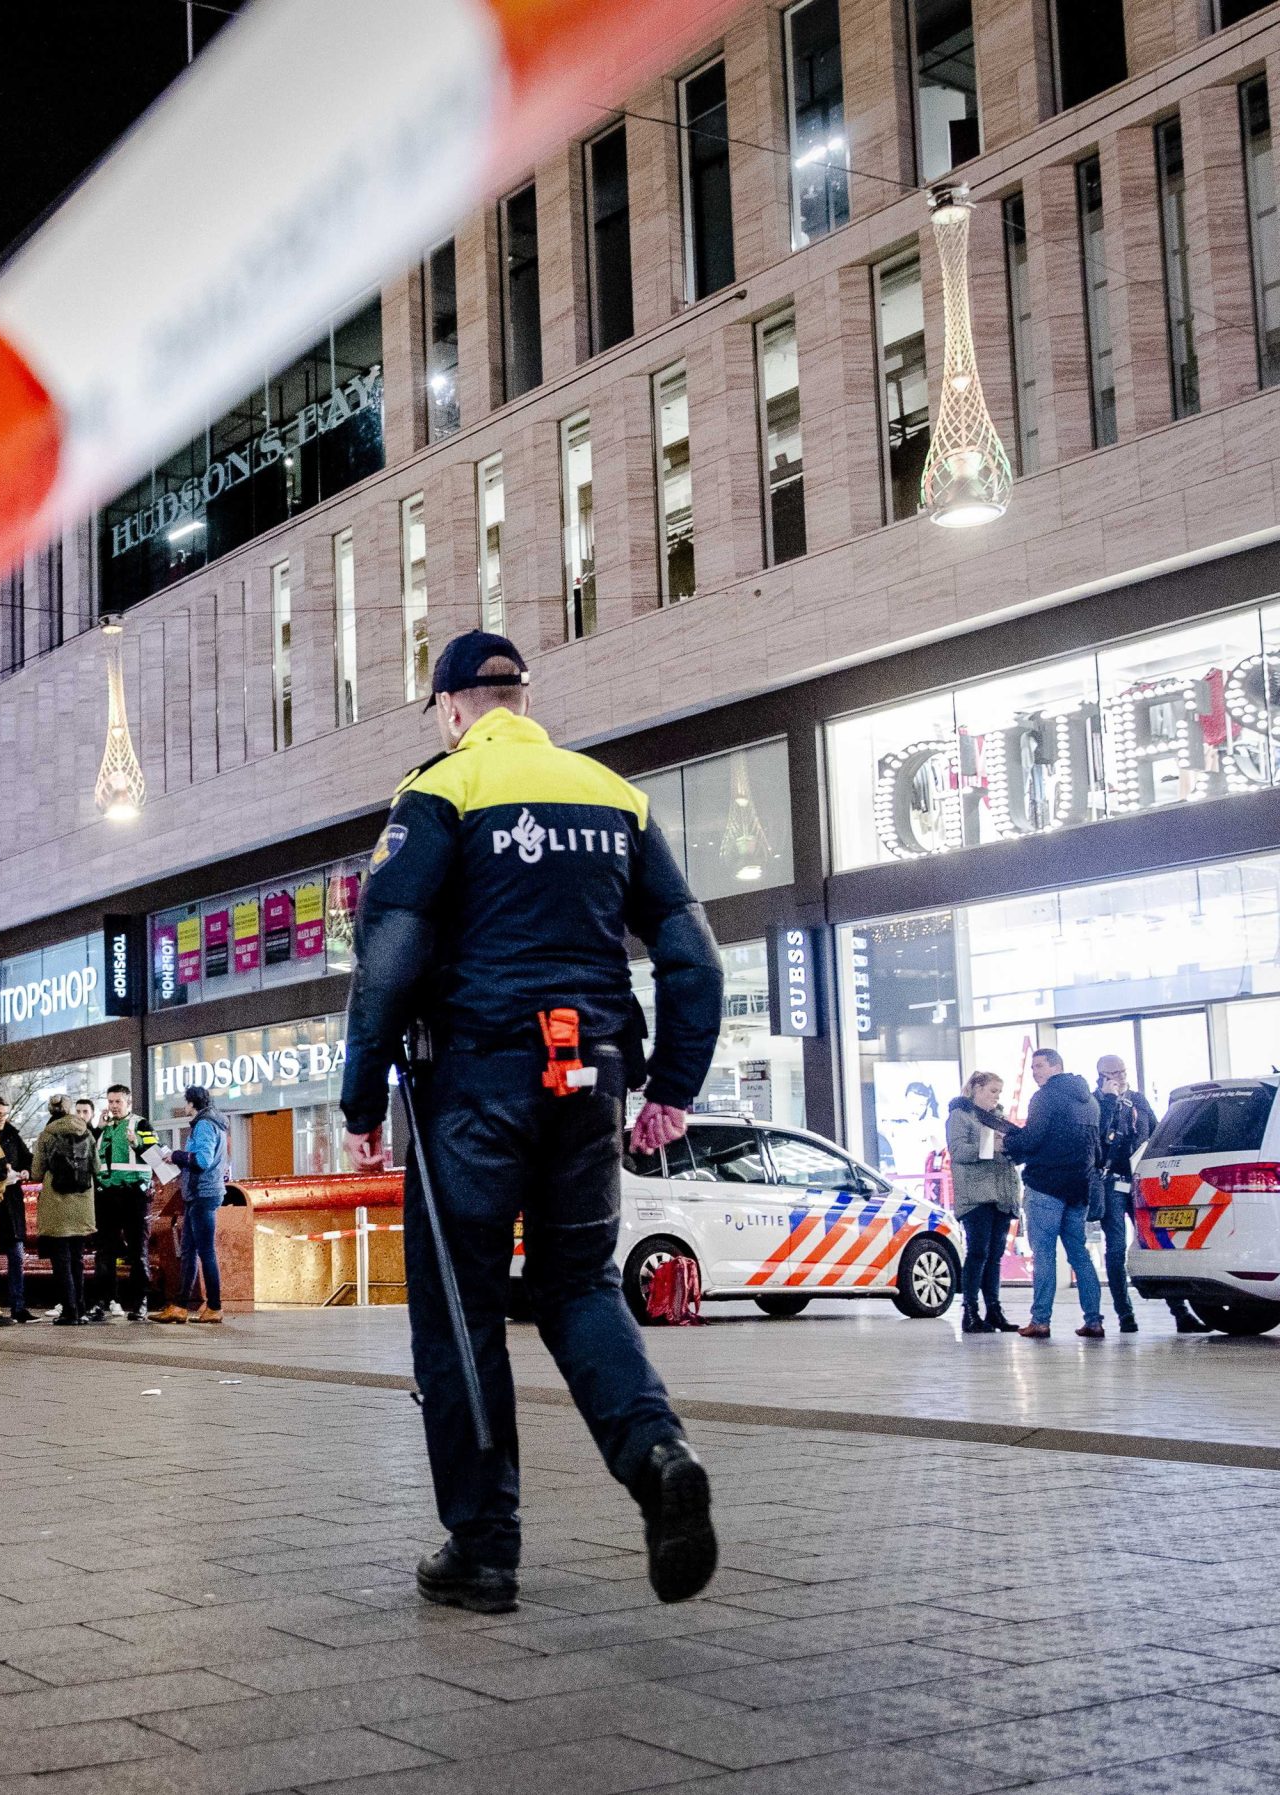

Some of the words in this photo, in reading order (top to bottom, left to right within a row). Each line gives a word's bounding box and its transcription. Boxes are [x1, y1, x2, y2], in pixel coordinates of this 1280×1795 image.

[492, 816, 628, 864] POLITIE
[113, 934, 127, 998] TOPSHOP
[787, 930, 808, 1030] GUESS
[1, 966, 98, 1024] TOPSHOP
[155, 1047, 301, 1096] HUDSON'S
[1157, 1160, 1181, 1168] POLITIE
[725, 1214, 784, 1231] POLITIE
